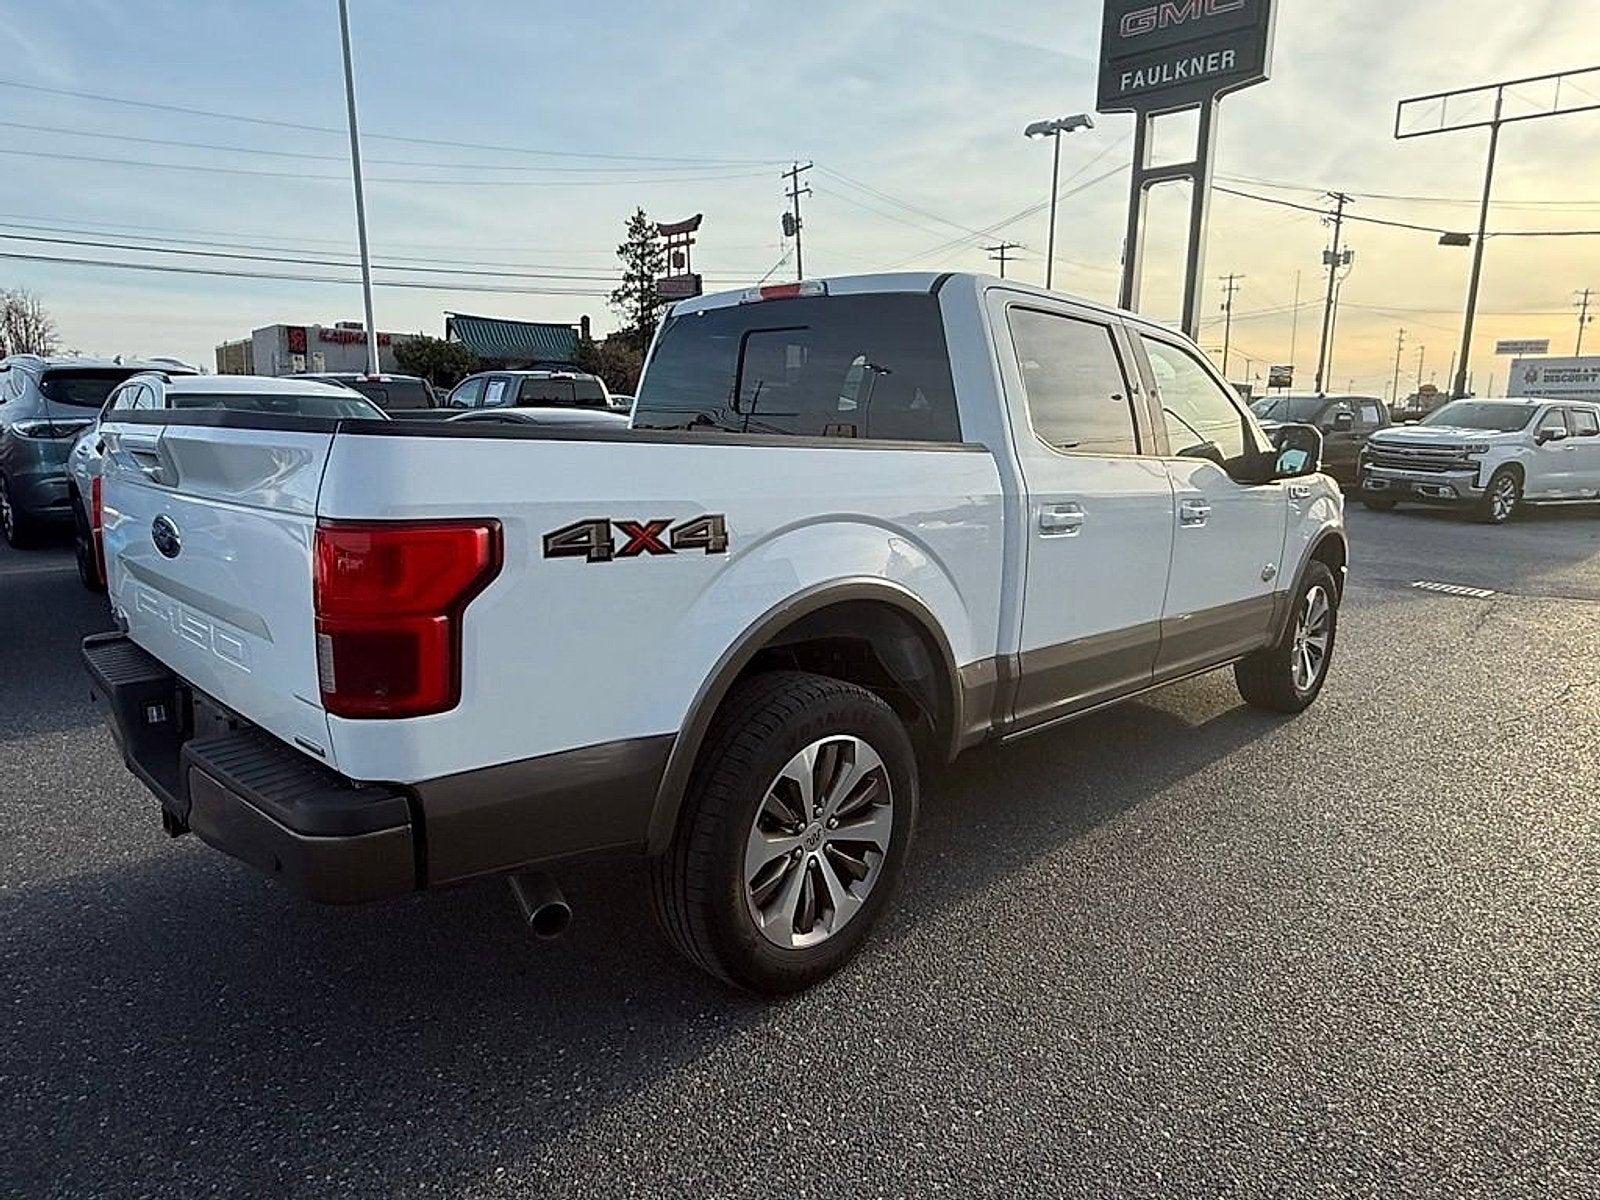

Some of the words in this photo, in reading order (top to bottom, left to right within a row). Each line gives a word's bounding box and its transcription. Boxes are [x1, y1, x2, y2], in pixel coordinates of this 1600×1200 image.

[1120, 49, 1236, 91] FAULKNER
[1543, 374, 1598, 383] DISCOUNT
[135, 584, 253, 674] F-150
